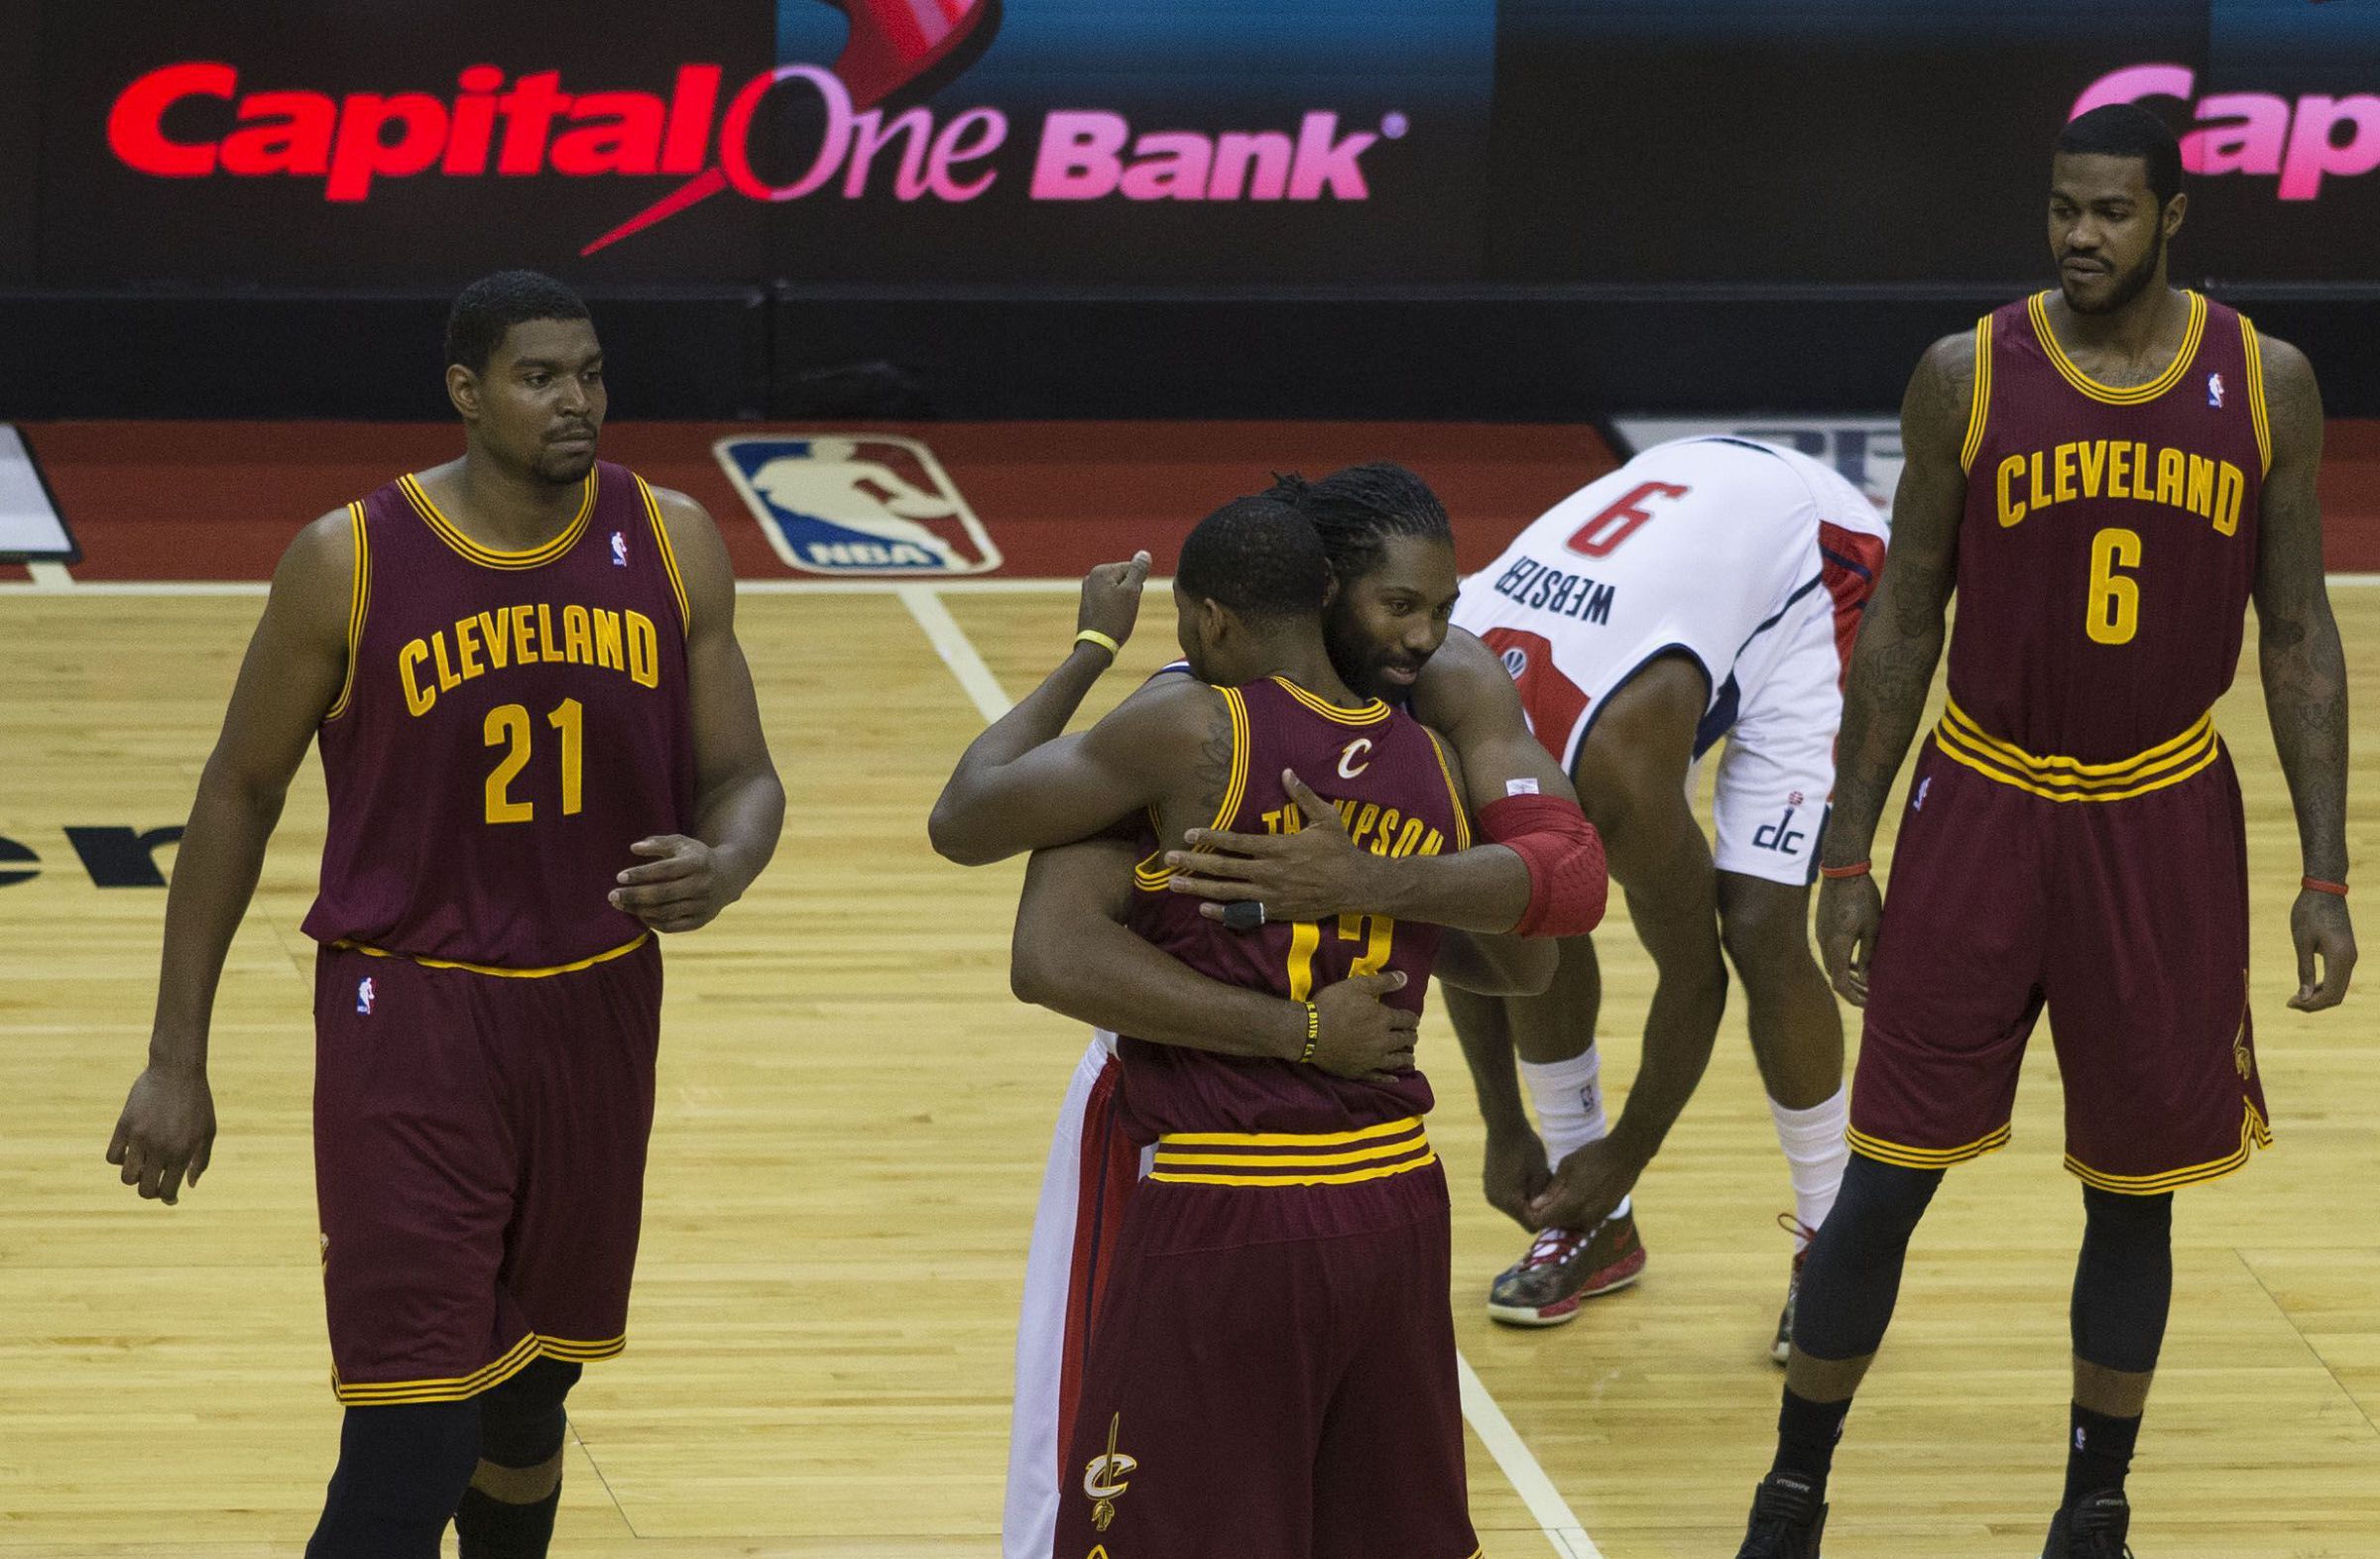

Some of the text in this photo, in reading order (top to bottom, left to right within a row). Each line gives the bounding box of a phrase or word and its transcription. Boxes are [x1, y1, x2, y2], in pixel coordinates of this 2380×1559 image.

[107, 61, 1372, 201] Capital One Bank
[1996, 439, 2245, 538] CLEVELAND
[807, 542, 934, 565] NBA
[1493, 555, 1616, 626] WEBSTER
[2085, 527, 2142, 646] 6
[398, 603, 659, 718] CLEVELAND
[483, 697, 584, 825] 21
[1261, 798, 1445, 859] THPSON
